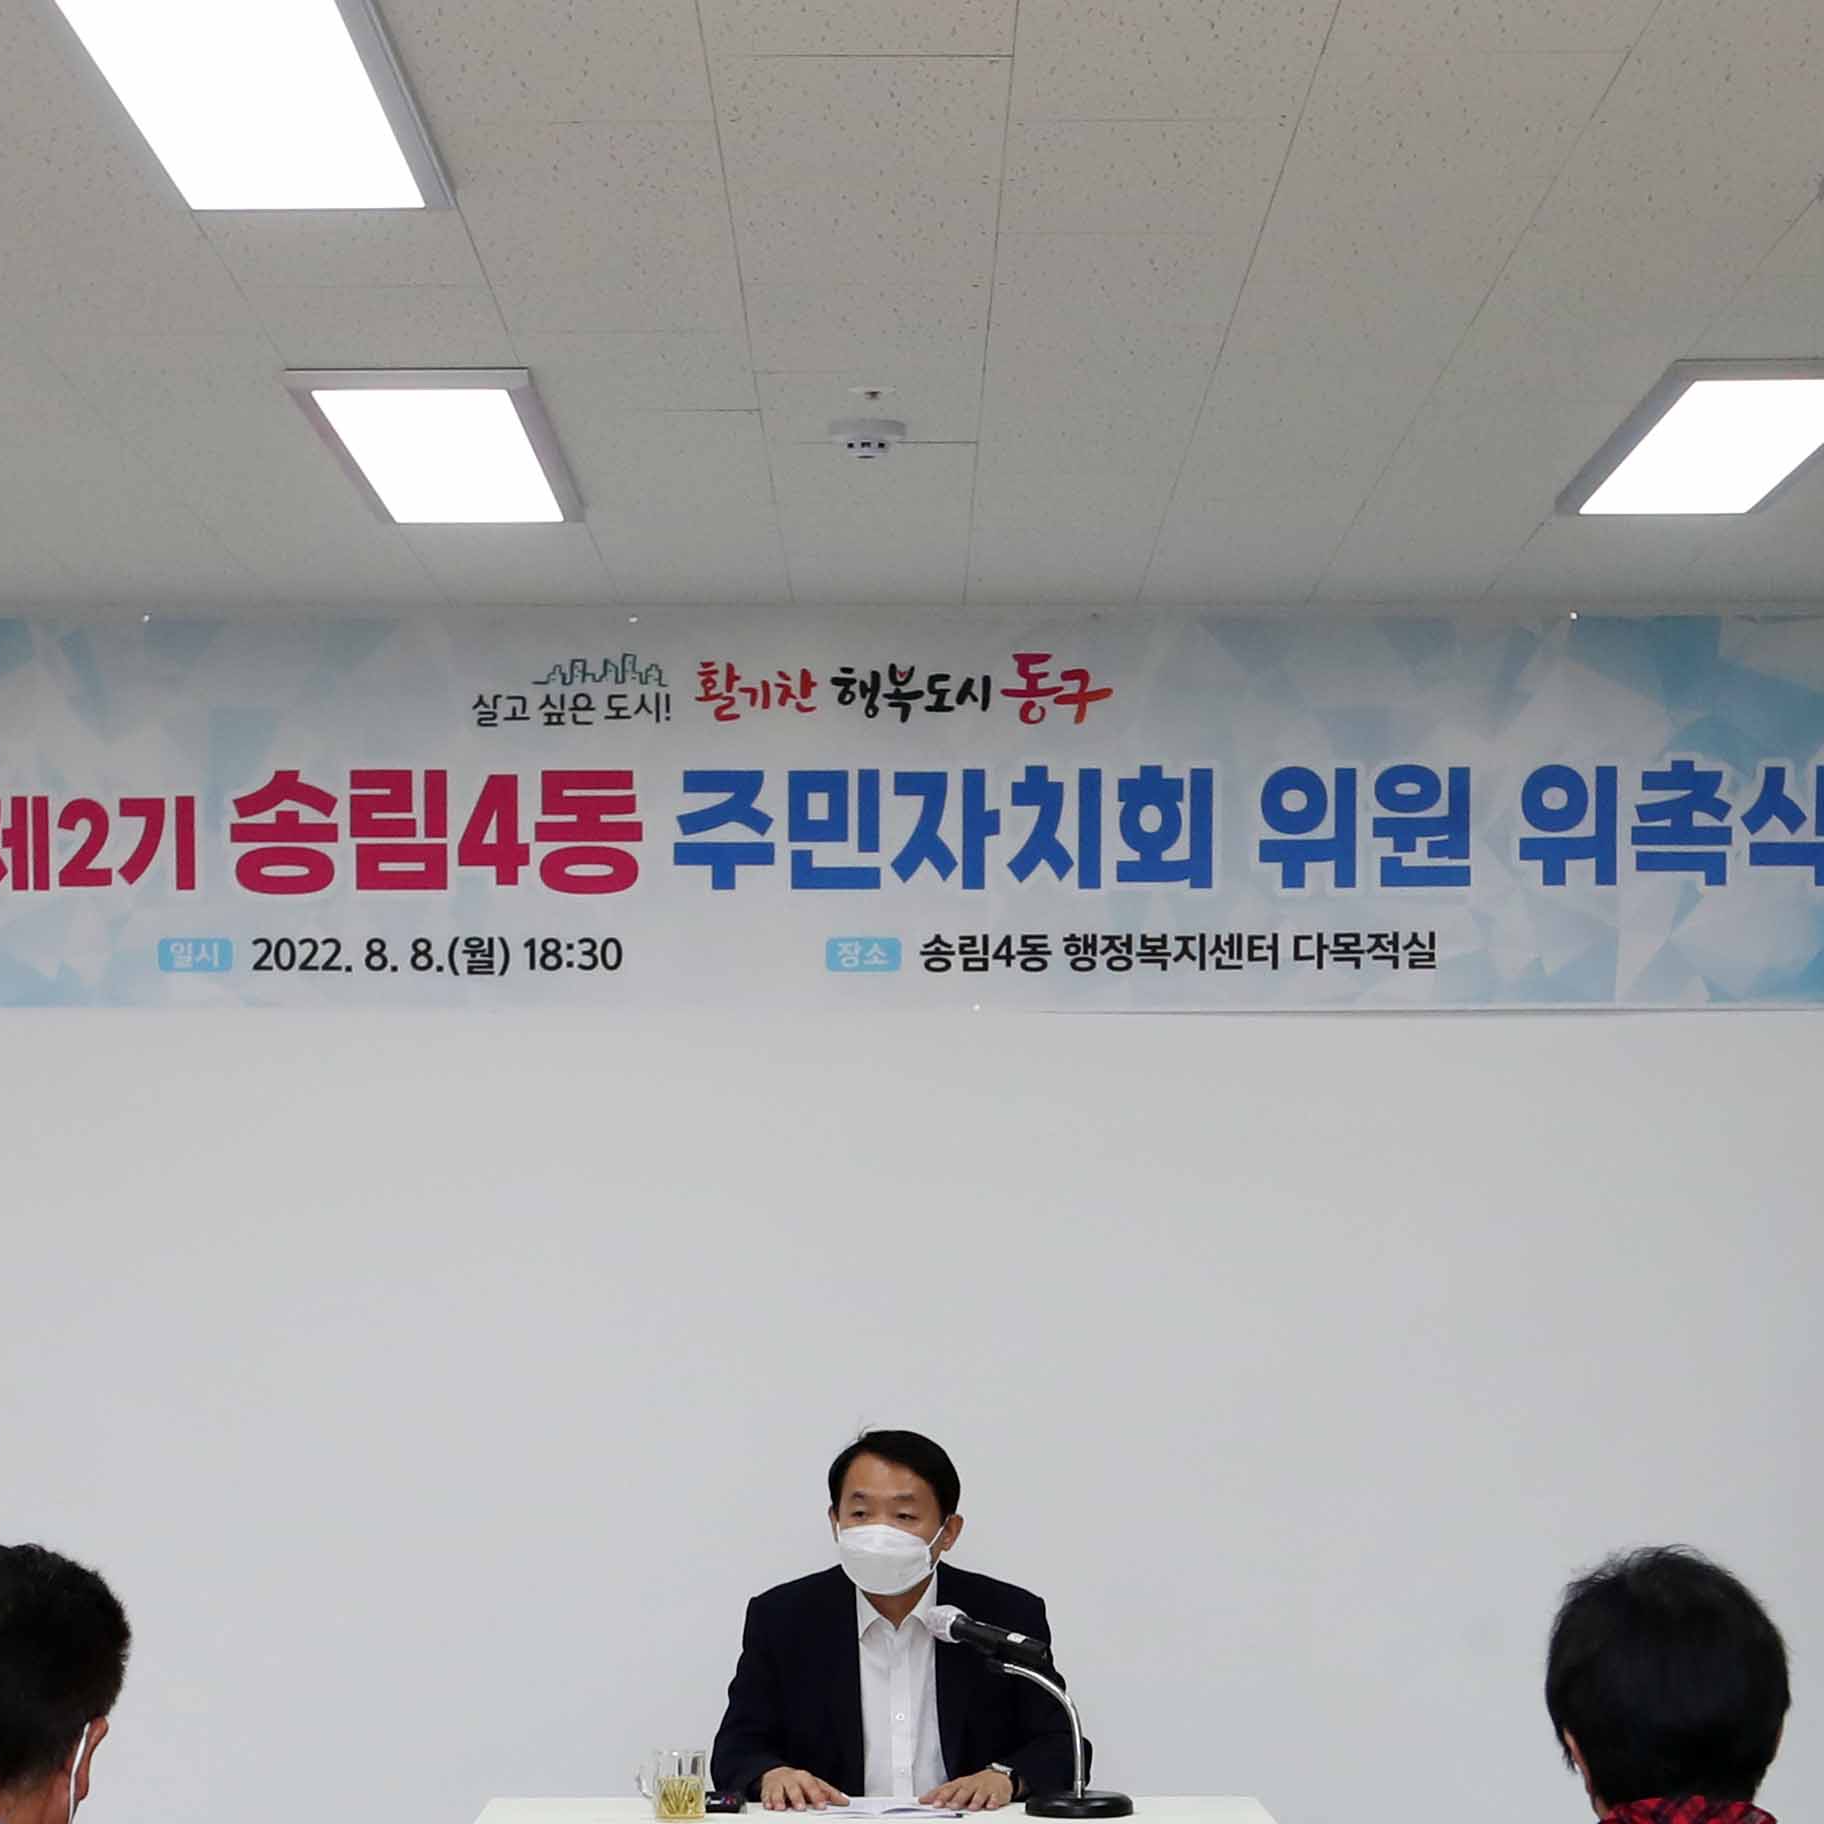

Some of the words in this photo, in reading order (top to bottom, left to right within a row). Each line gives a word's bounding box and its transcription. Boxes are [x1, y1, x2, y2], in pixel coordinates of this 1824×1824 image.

[694, 661, 818, 722] 활기찬
[830, 663, 991, 723] 행복도시
[1001, 653, 1114, 724] 동구
[472, 694, 530, 725] 살고
[539, 694, 596, 725] 싶은
[604, 694, 672, 725] 도시!
[229, 768, 644, 893] 송림4동
[673, 764, 1214, 890] 주민자치회
[1259, 764, 1472, 889] 위원
[169, 941, 220, 968] 일시
[251, 938, 353, 972] 2022.
[364, 938, 399, 972] 8.
[523, 937, 624, 971] 18:30
[836, 940, 888, 967] 장소
[919, 934, 1052, 972] 송림4동
[1063, 931, 1278, 972] 행정복지센터
[1292, 931, 1439, 970] 다목적실
